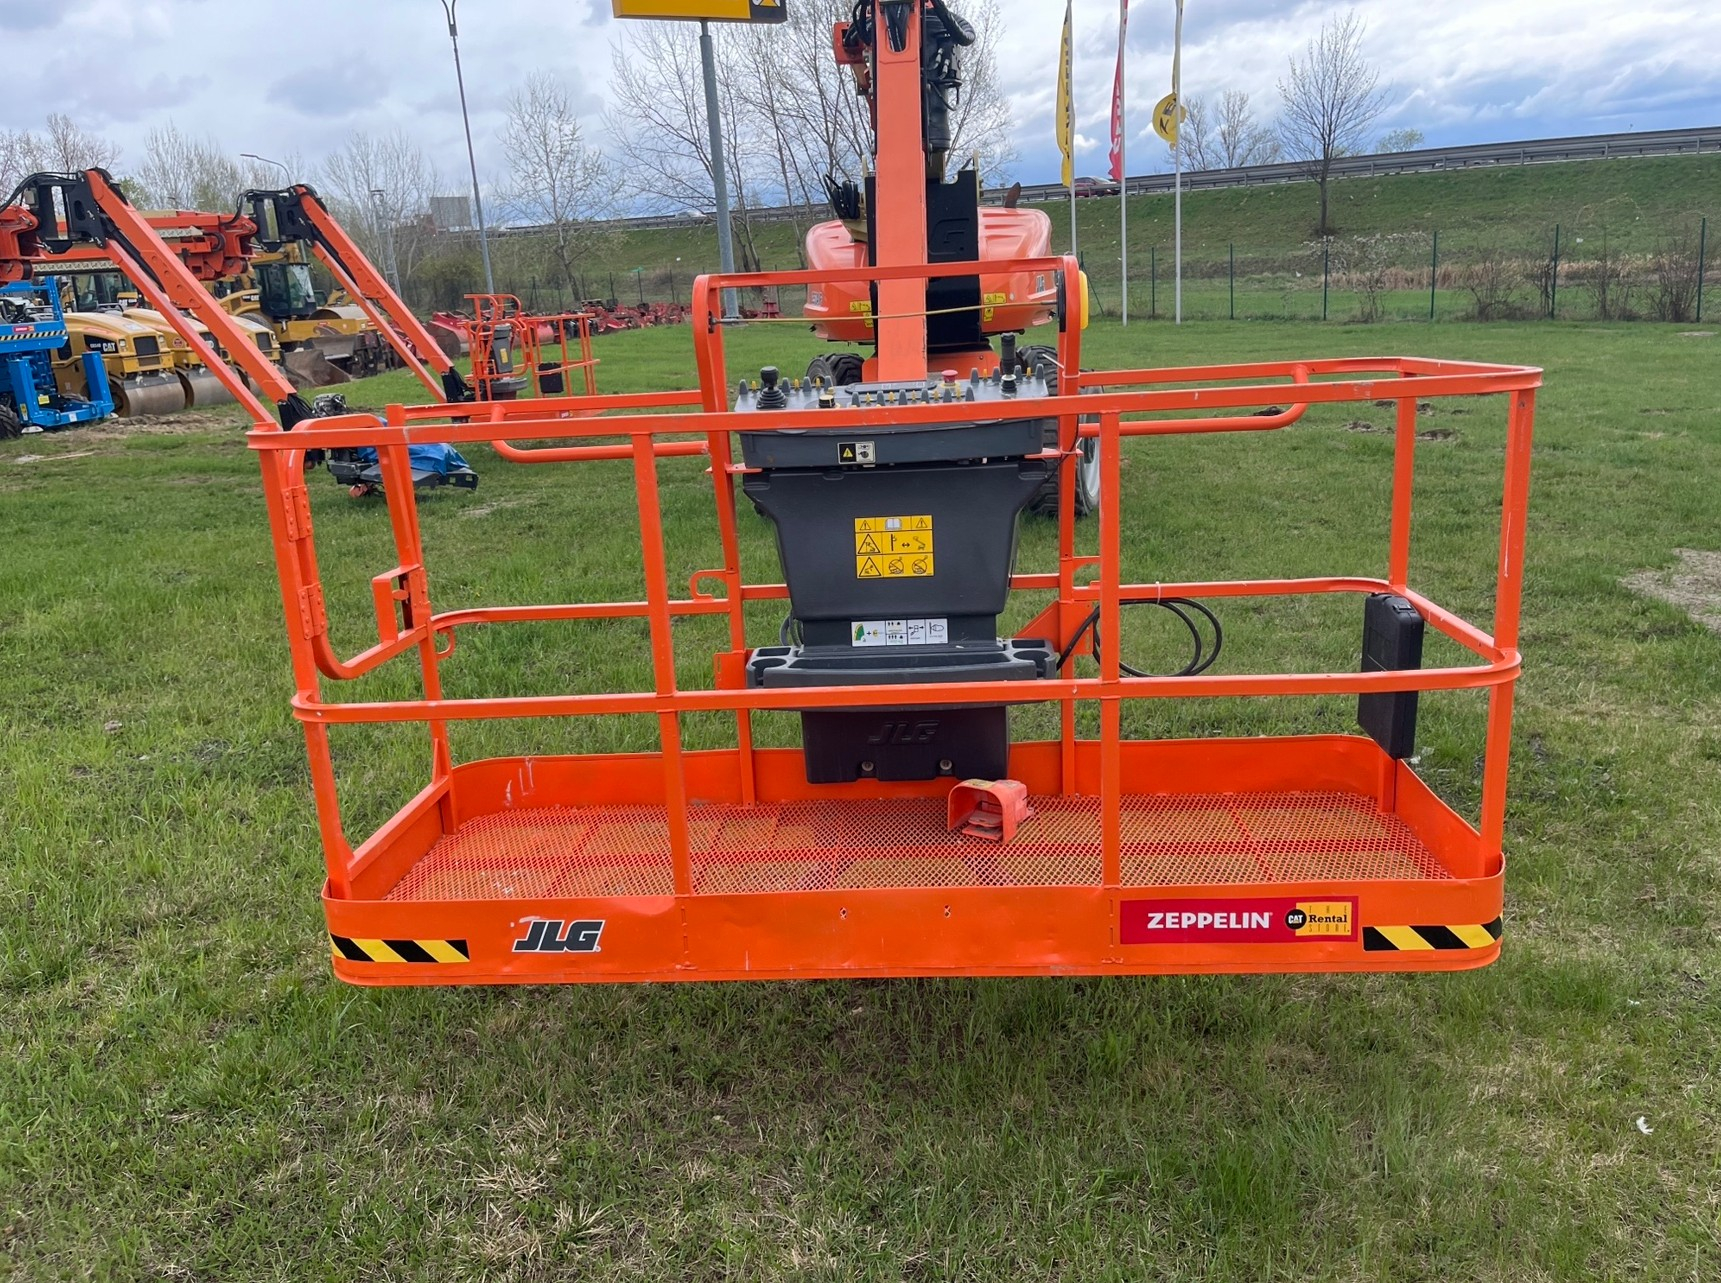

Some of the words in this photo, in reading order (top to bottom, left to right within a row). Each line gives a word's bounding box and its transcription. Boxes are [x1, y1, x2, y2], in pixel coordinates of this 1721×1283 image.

[102, 342, 116, 352] CAT
[867, 721, 939, 745] JLG
[1147, 912, 1271, 929] ZEPPELIN
[1288, 914, 1304, 925] CAT
[1309, 914, 1348, 924] Rental
[512, 919, 606, 953] JLG
